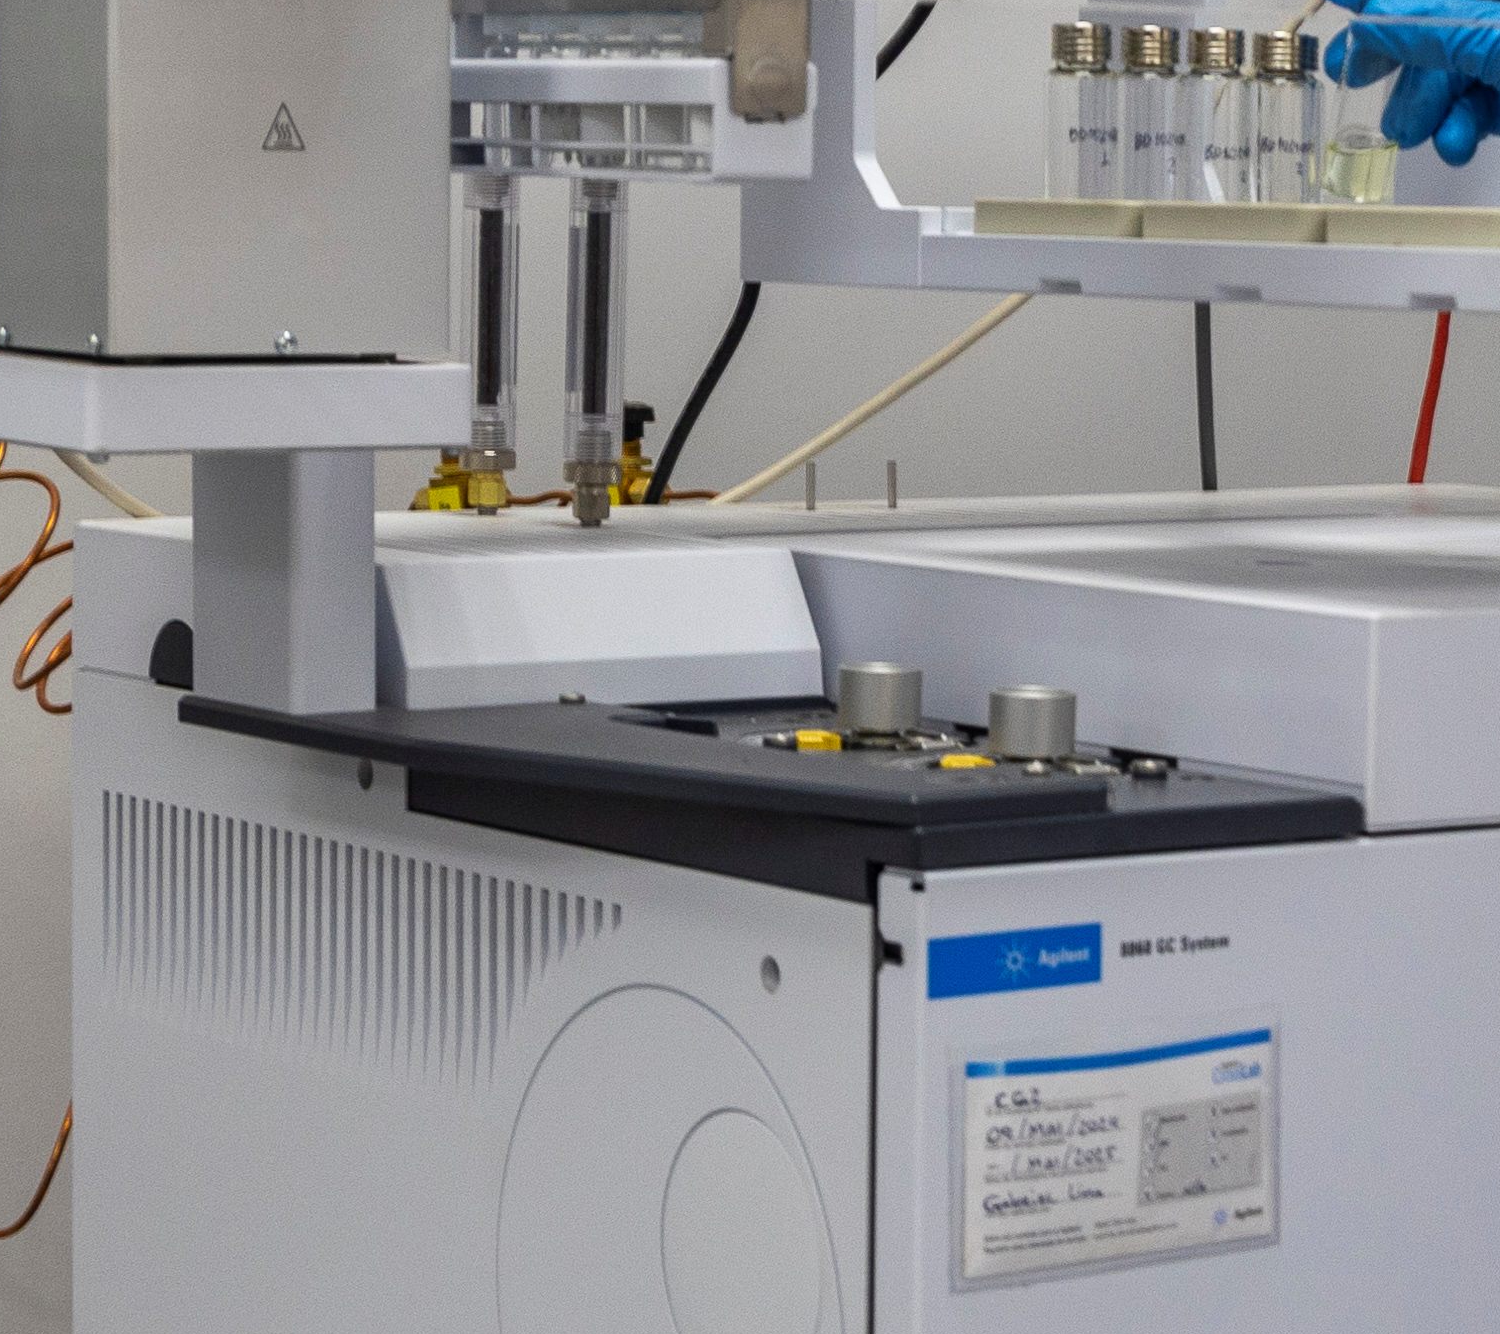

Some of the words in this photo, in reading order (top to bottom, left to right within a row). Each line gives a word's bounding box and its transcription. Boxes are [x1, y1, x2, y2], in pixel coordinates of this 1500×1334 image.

[1156, 936, 1178, 955] GC
[1180, 933, 1230, 955] System
[1037, 945, 1091, 970] Agilent
